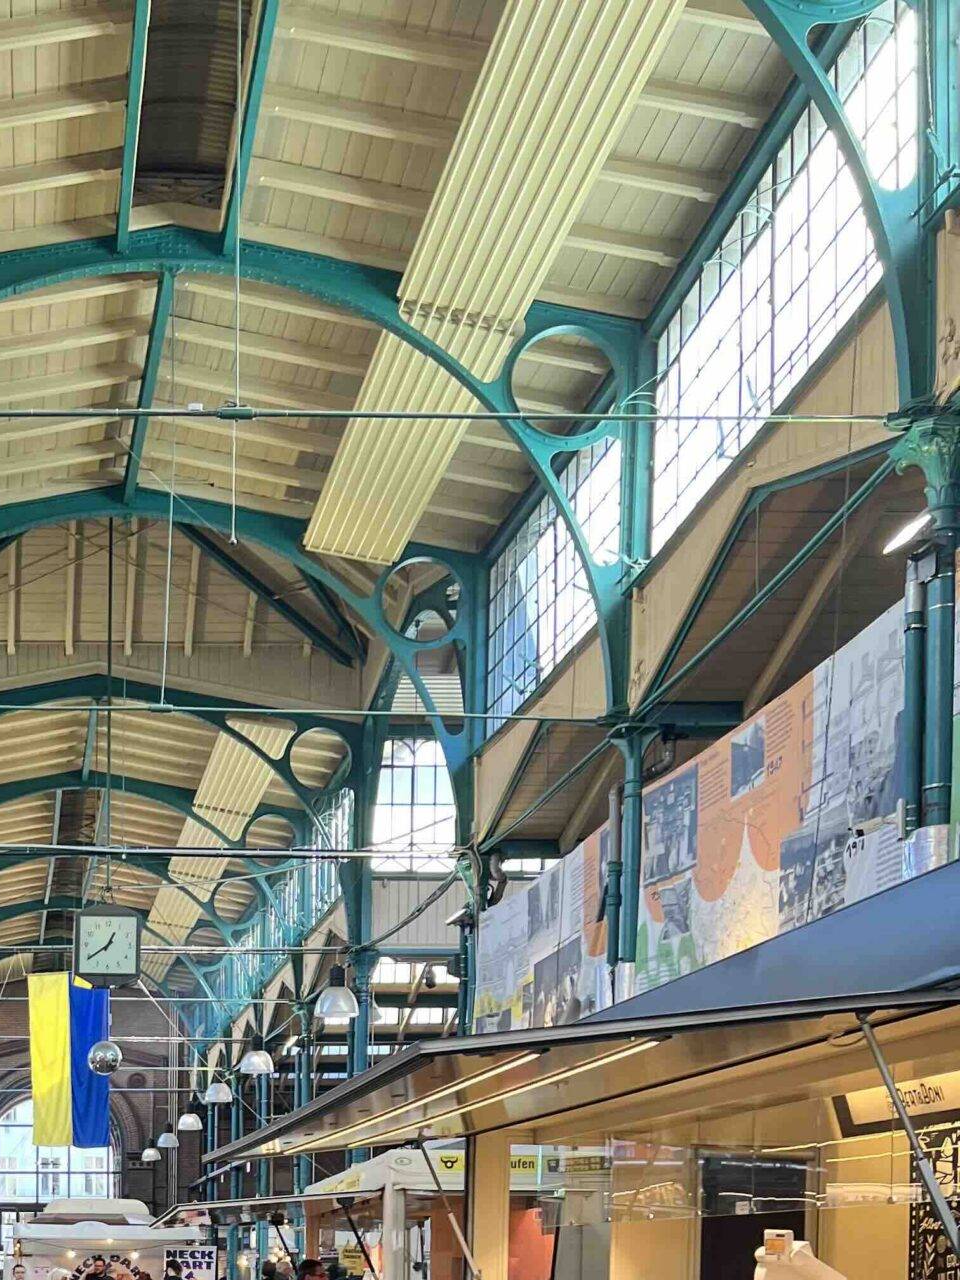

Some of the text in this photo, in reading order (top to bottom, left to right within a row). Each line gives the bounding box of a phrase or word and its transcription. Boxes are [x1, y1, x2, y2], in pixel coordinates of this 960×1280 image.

[510, 1159, 535, 1169] ufen
[166, 1249, 214, 1260] NECK
[180, 1260, 214, 1270] ART
